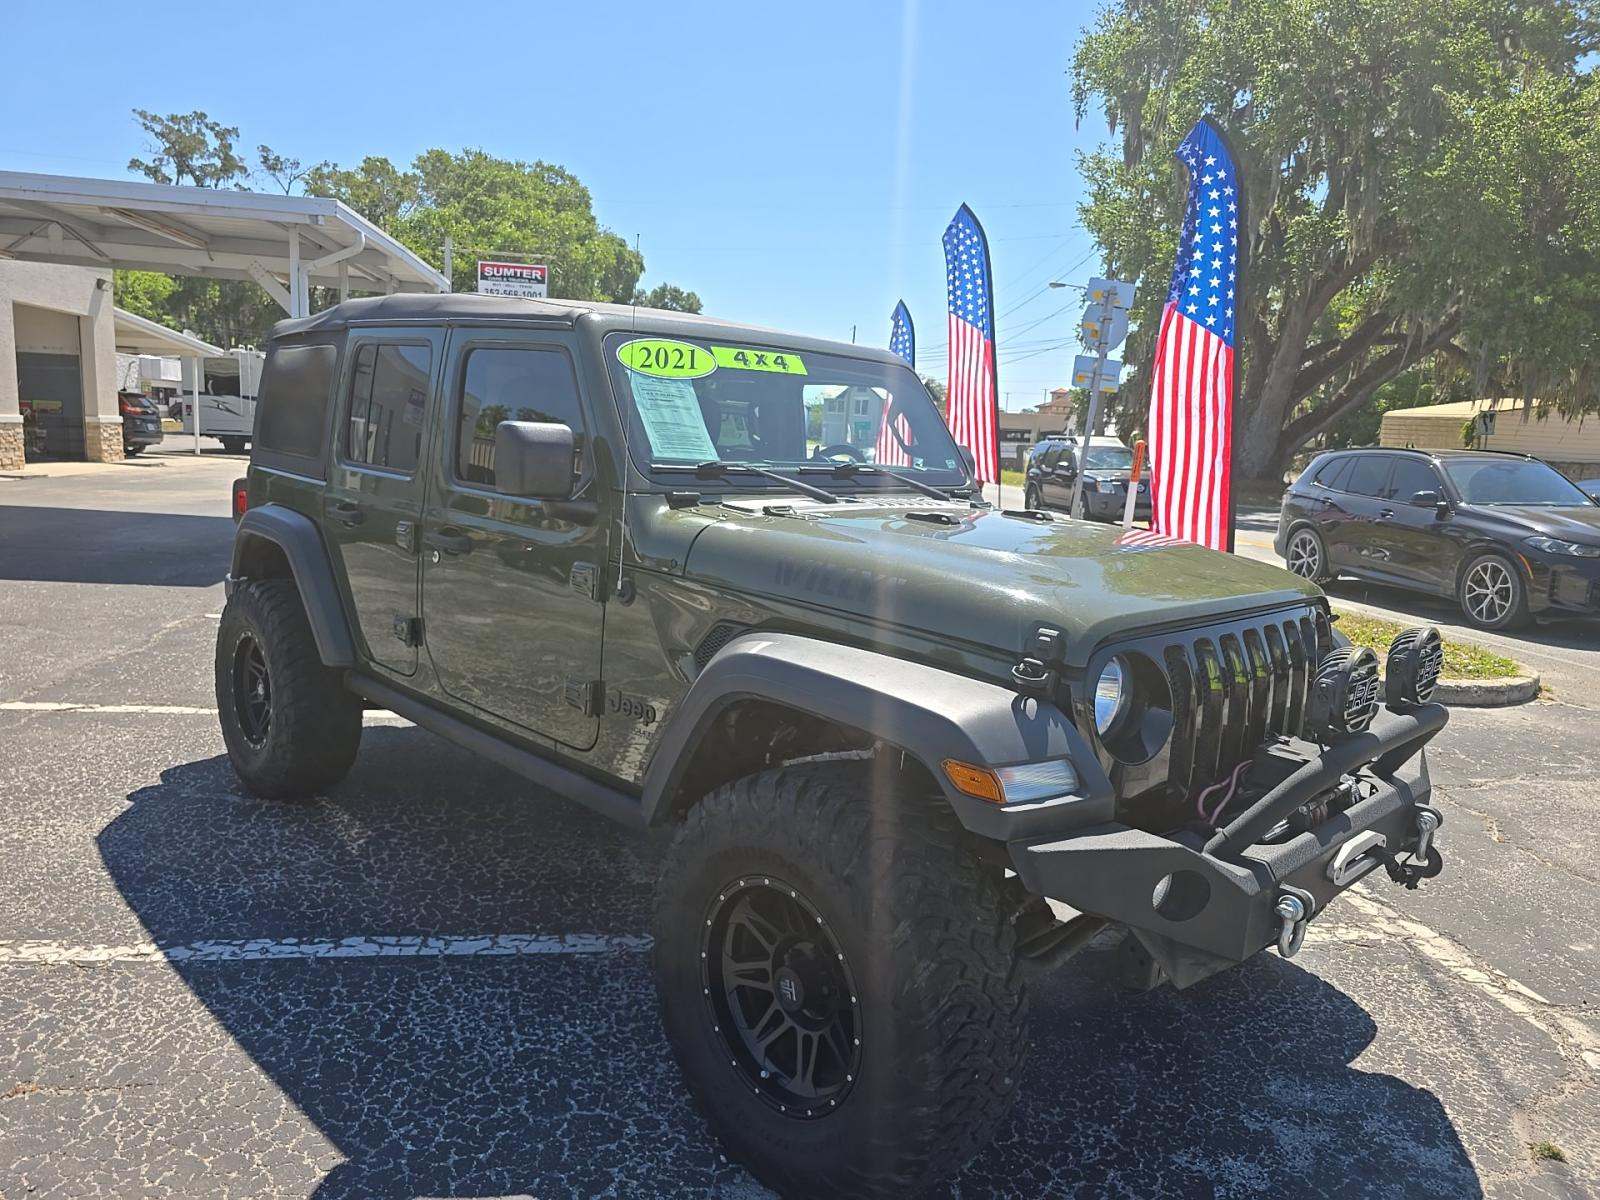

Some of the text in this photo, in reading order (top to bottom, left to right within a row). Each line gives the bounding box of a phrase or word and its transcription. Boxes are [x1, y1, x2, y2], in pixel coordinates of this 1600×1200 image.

[484, 266, 542, 280] SUMTER
[639, 347, 698, 370] 2021
[608, 690, 656, 727] Jeep
